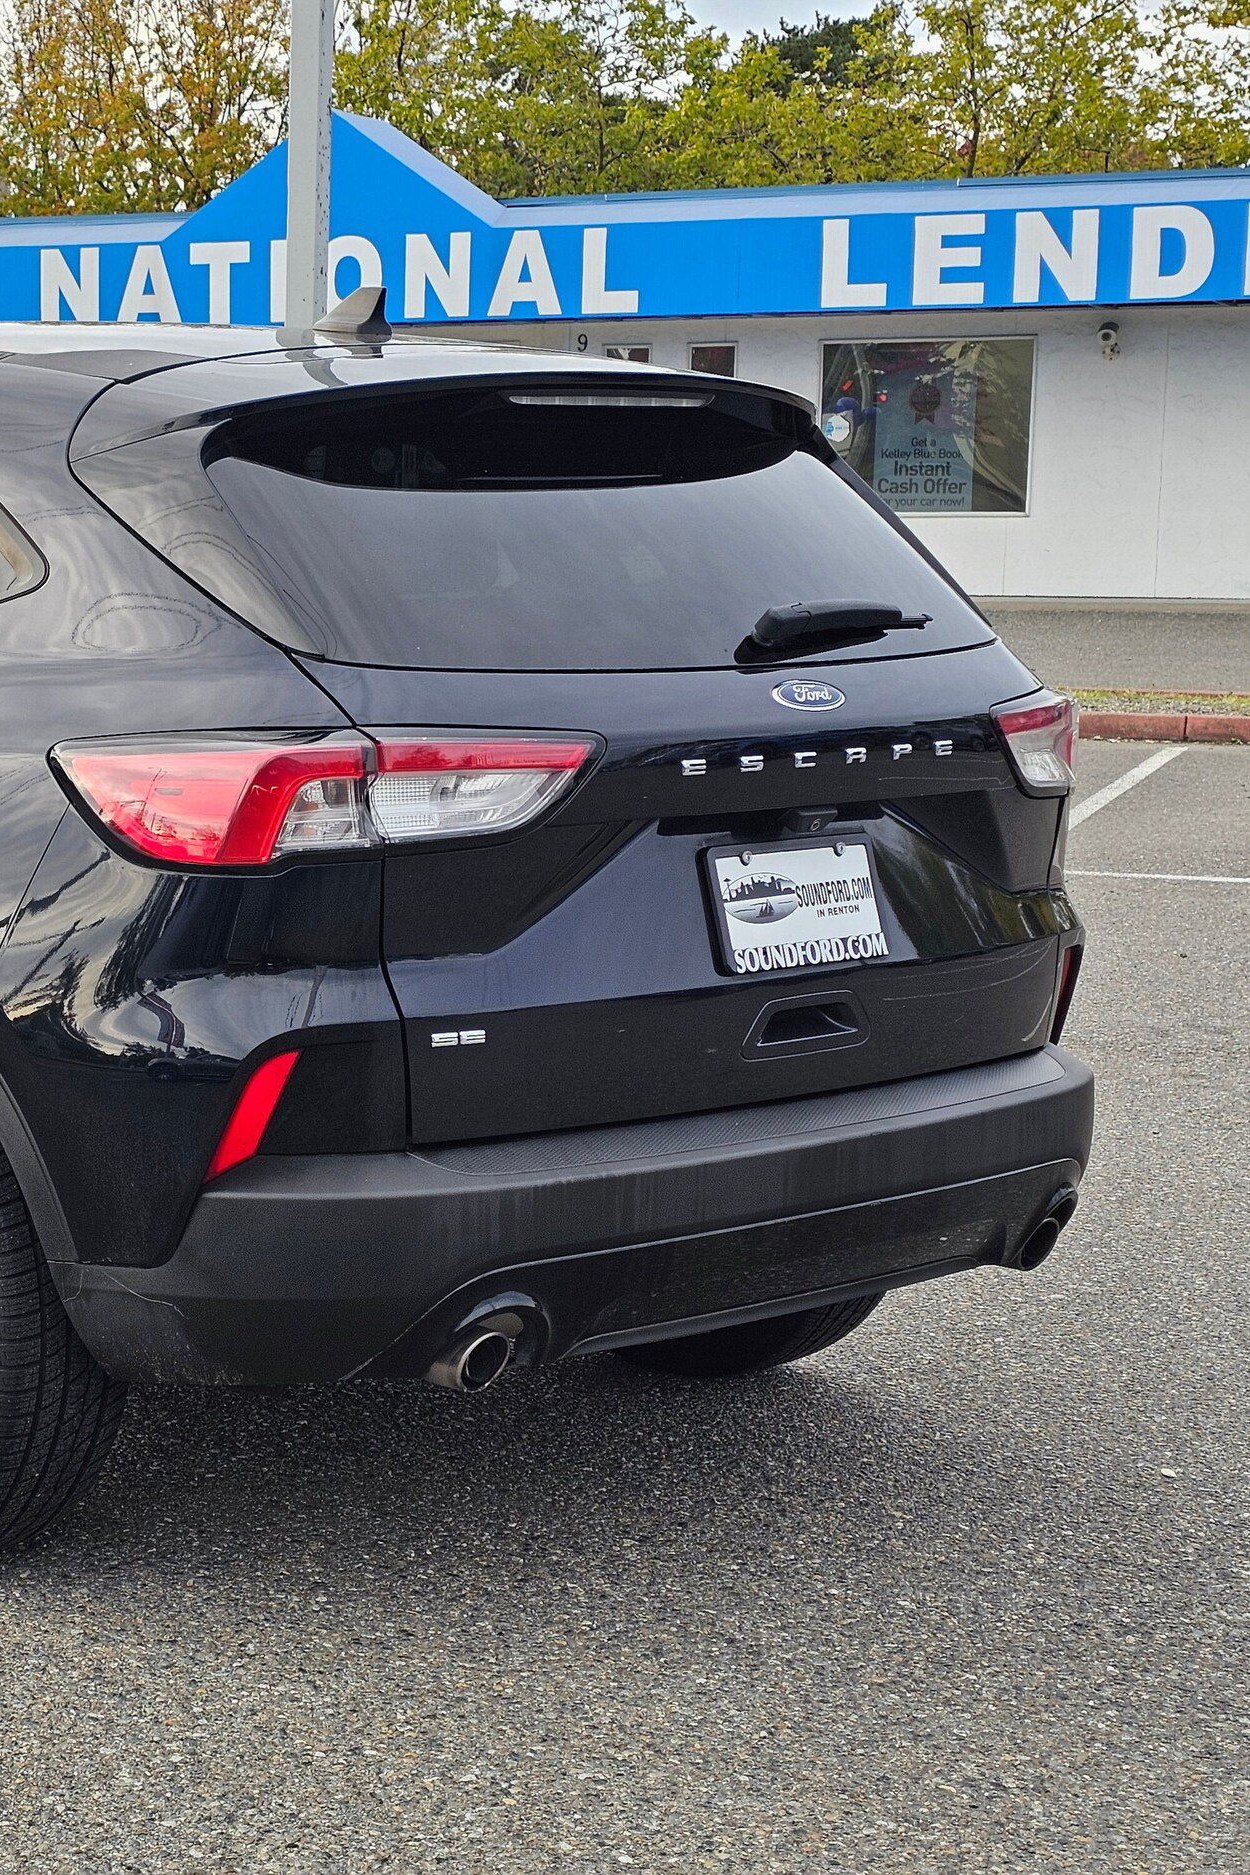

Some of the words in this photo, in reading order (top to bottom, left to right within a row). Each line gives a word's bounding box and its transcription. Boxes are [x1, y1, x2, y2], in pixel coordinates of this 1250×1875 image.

[39, 228, 639, 326] NATIONAL
[821, 202, 1250, 308] LEND
[577, 333, 588, 352] 9
[911, 437, 927, 448] Get
[881, 449, 911, 461] Kelley
[913, 449, 936, 459] Blue
[893, 460, 952, 477] Instant
[877, 478, 918, 494] Cash
[923, 478, 967, 494] Offer
[895, 498, 917, 509] your
[920, 499, 936, 507] car
[939, 497, 965, 507] now!
[792, 684, 832, 702] Ford
[681, 739, 954, 777] ESCAPE
[795, 876, 873, 908] SOUNDFORD.COM
[816, 908, 826, 918] IN
[828, 904, 860, 917] RENTON
[733, 932, 890, 974] SOUNDFORD.COM
[431, 1029, 486, 1048] SE
